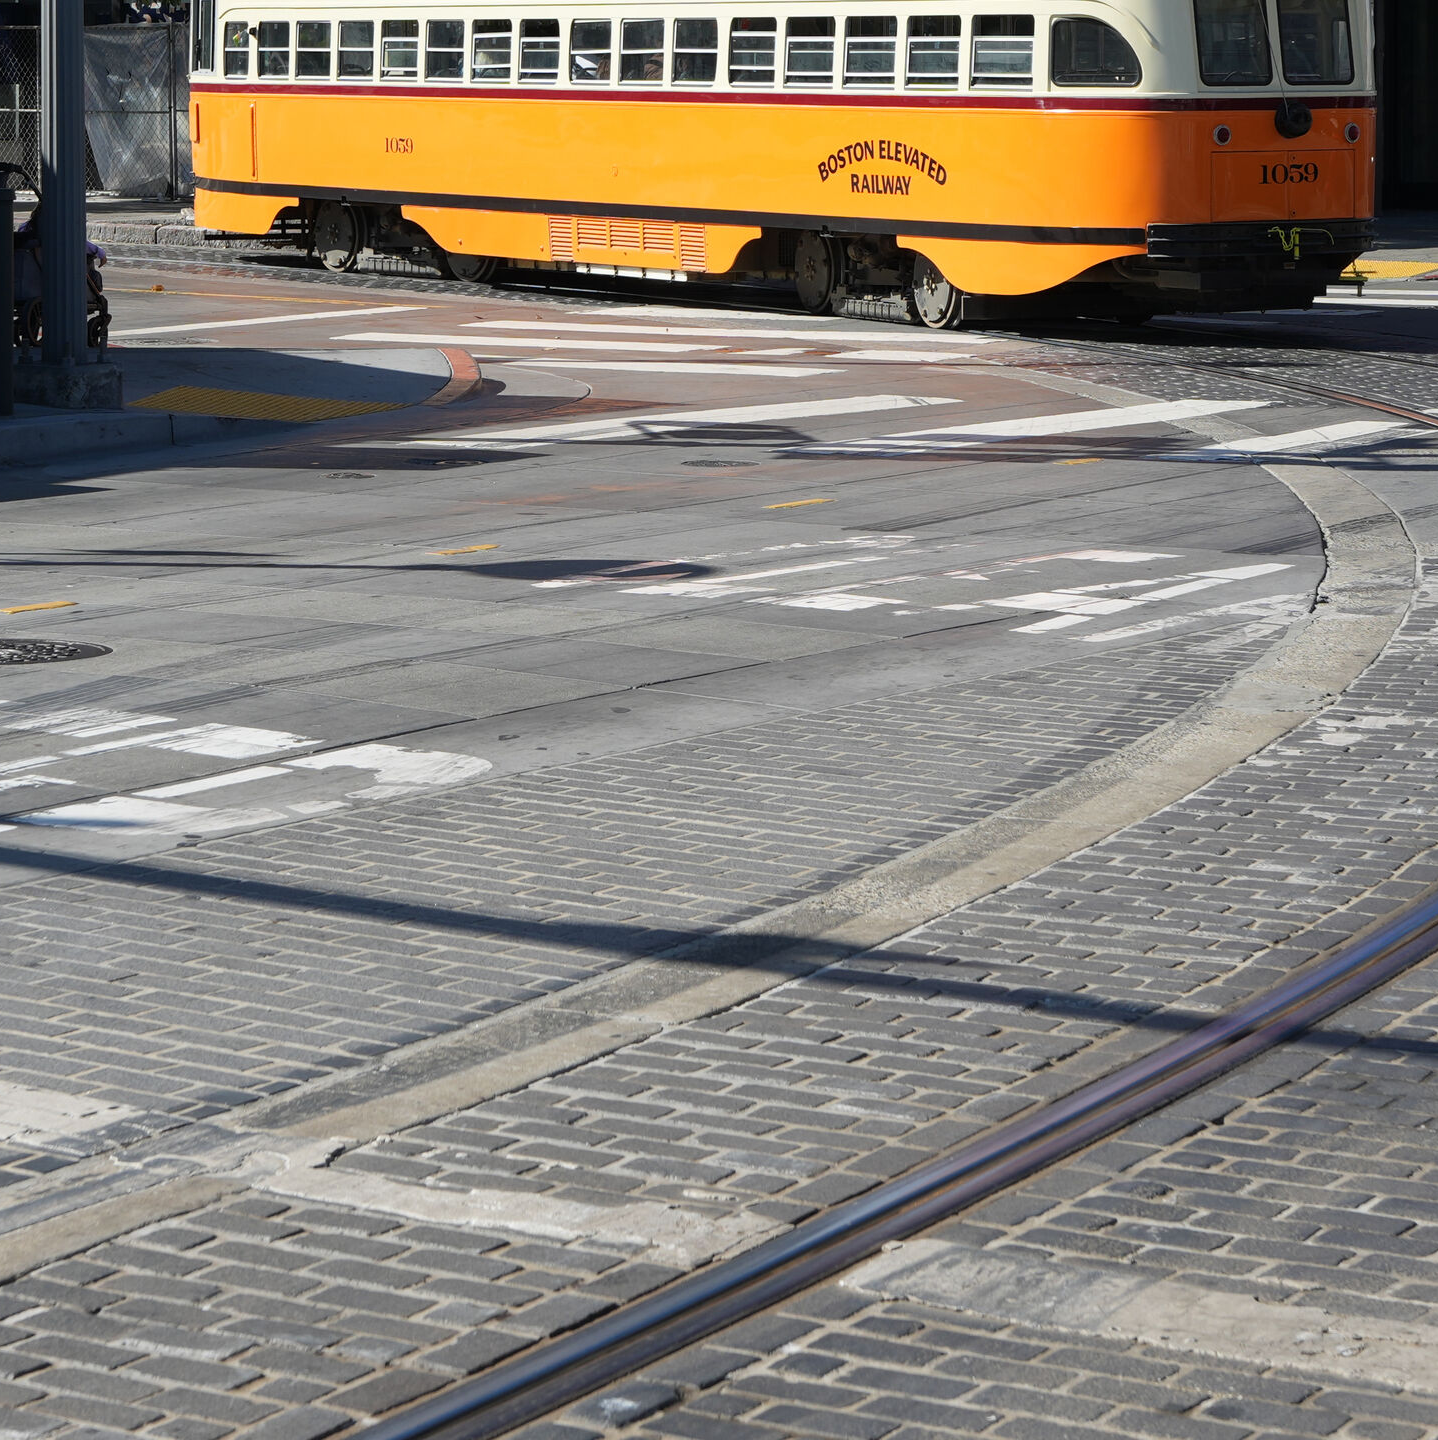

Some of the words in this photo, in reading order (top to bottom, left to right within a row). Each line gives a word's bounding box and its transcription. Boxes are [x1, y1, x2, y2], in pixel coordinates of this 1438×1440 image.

[384, 136, 414, 154] 1059
[817, 139, 875, 183] BOSTON
[878, 139, 948, 186] ELEVATED
[1258, 162, 1319, 185] 1059
[850, 173, 912, 196] RAILWAY
